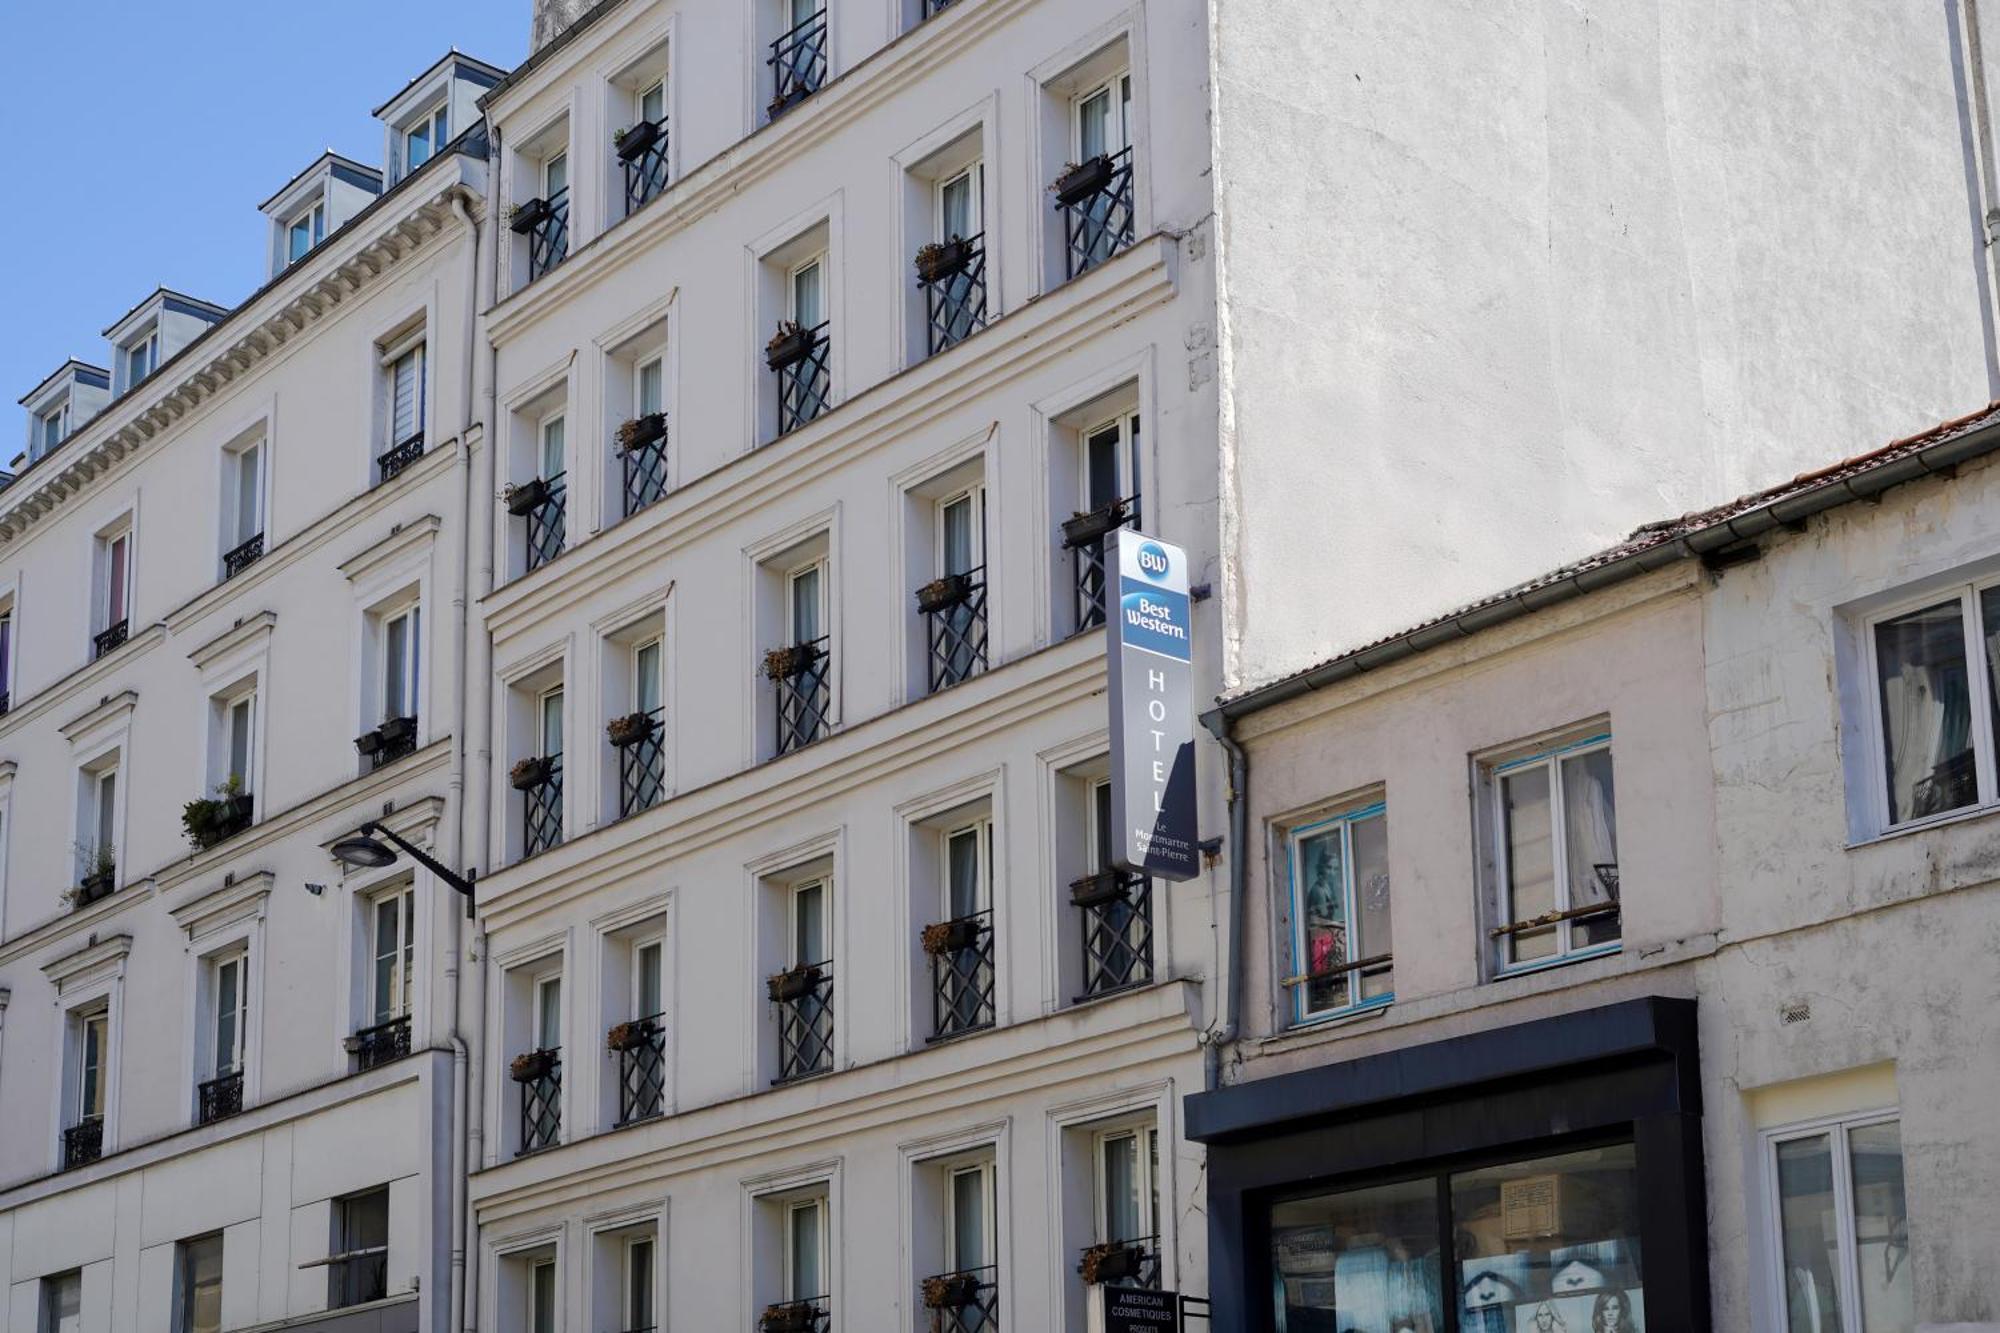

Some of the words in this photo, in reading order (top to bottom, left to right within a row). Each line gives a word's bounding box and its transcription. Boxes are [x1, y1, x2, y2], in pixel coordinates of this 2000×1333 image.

[1140, 552, 1166, 572] BW
[1140, 599, 1171, 620] Best
[1127, 609, 1184, 639] Western
[1149, 669, 1165, 812] HOTEL
[1157, 821, 1167, 832] Le
[1135, 829, 1189, 849] Montmartre
[1120, 1294, 1163, 1307] AMERICAN
[1111, 1306, 1171, 1320] COSMETIQUES
